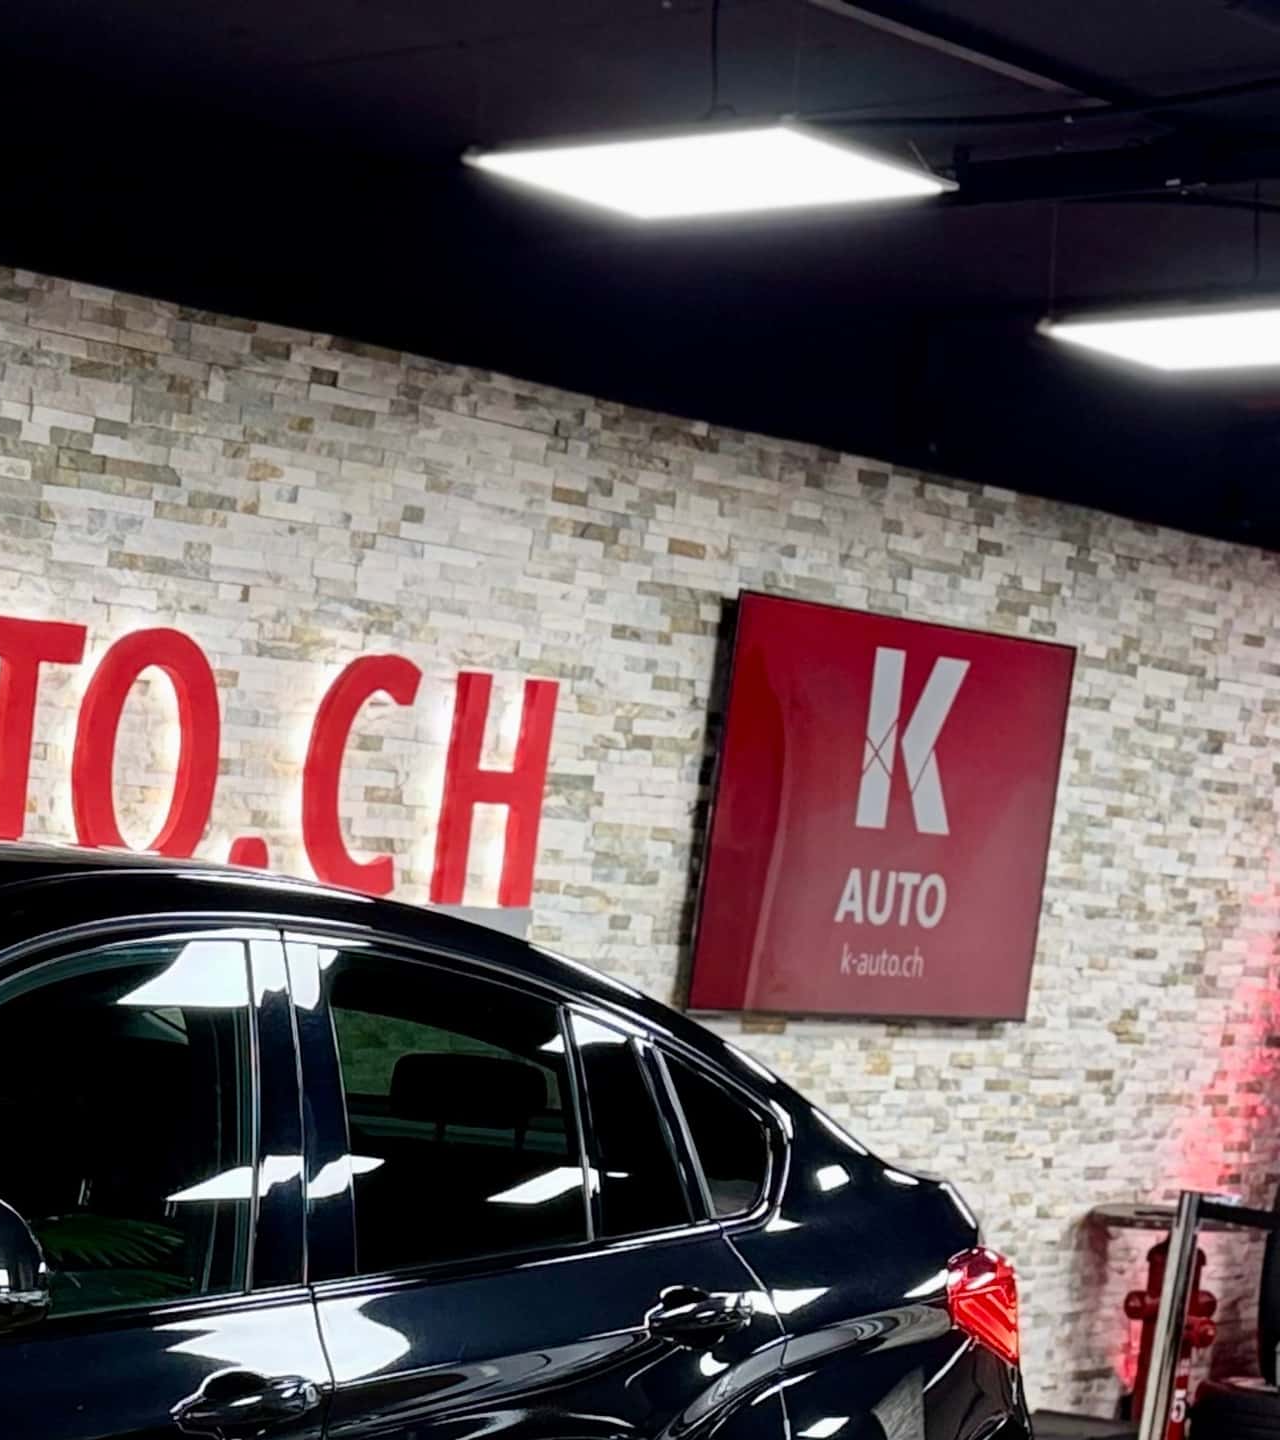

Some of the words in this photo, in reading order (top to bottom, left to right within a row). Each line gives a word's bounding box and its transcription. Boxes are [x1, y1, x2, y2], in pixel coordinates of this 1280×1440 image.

[855, 646, 971, 836] K
[834, 868, 947, 928] AUTO
[840, 943, 924, 978] k-auto.ch
